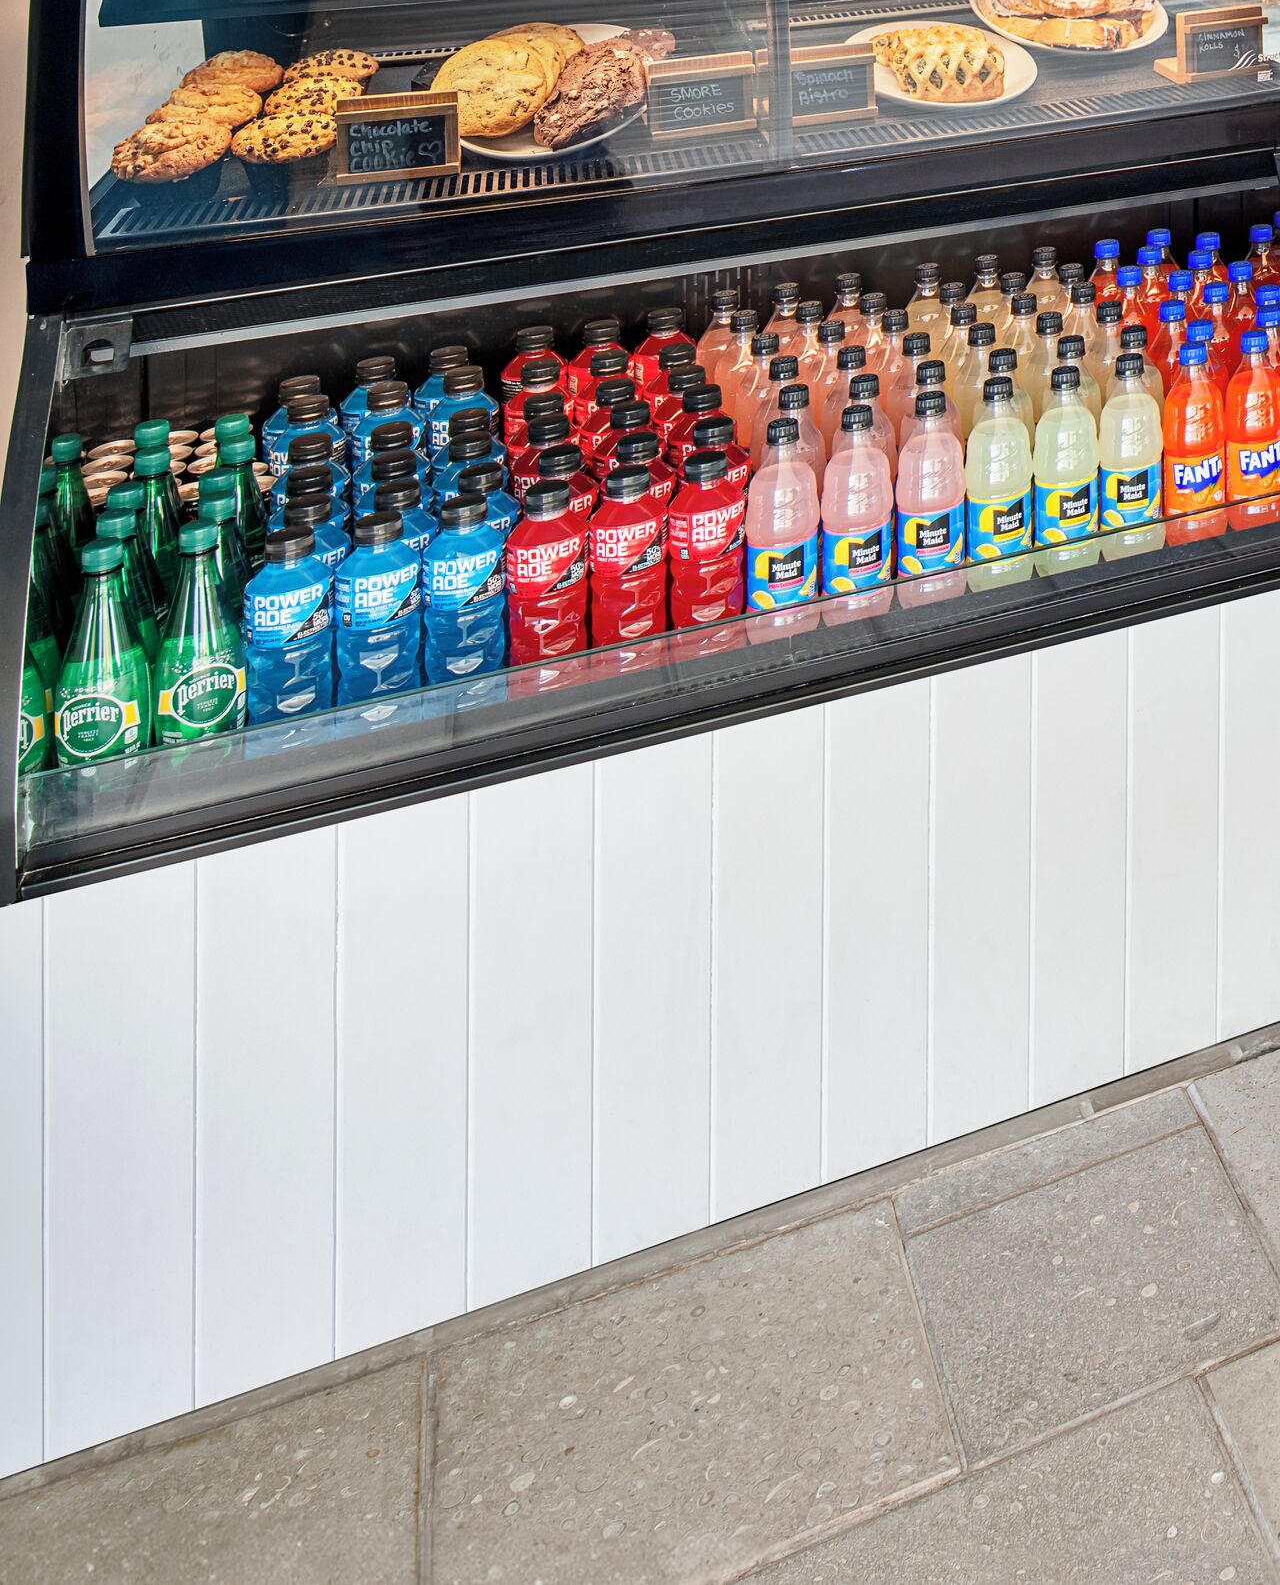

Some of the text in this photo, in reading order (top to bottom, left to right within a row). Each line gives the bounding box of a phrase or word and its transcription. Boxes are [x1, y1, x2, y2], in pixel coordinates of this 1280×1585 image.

[997, 512, 1022, 524] Minute
[1000, 520, 1019, 531] Maid
[596, 521, 656, 543] POWER
[596, 543, 629, 557] ADE
[254, 584, 324, 609] POWER
[254, 609, 293, 626] ADE
